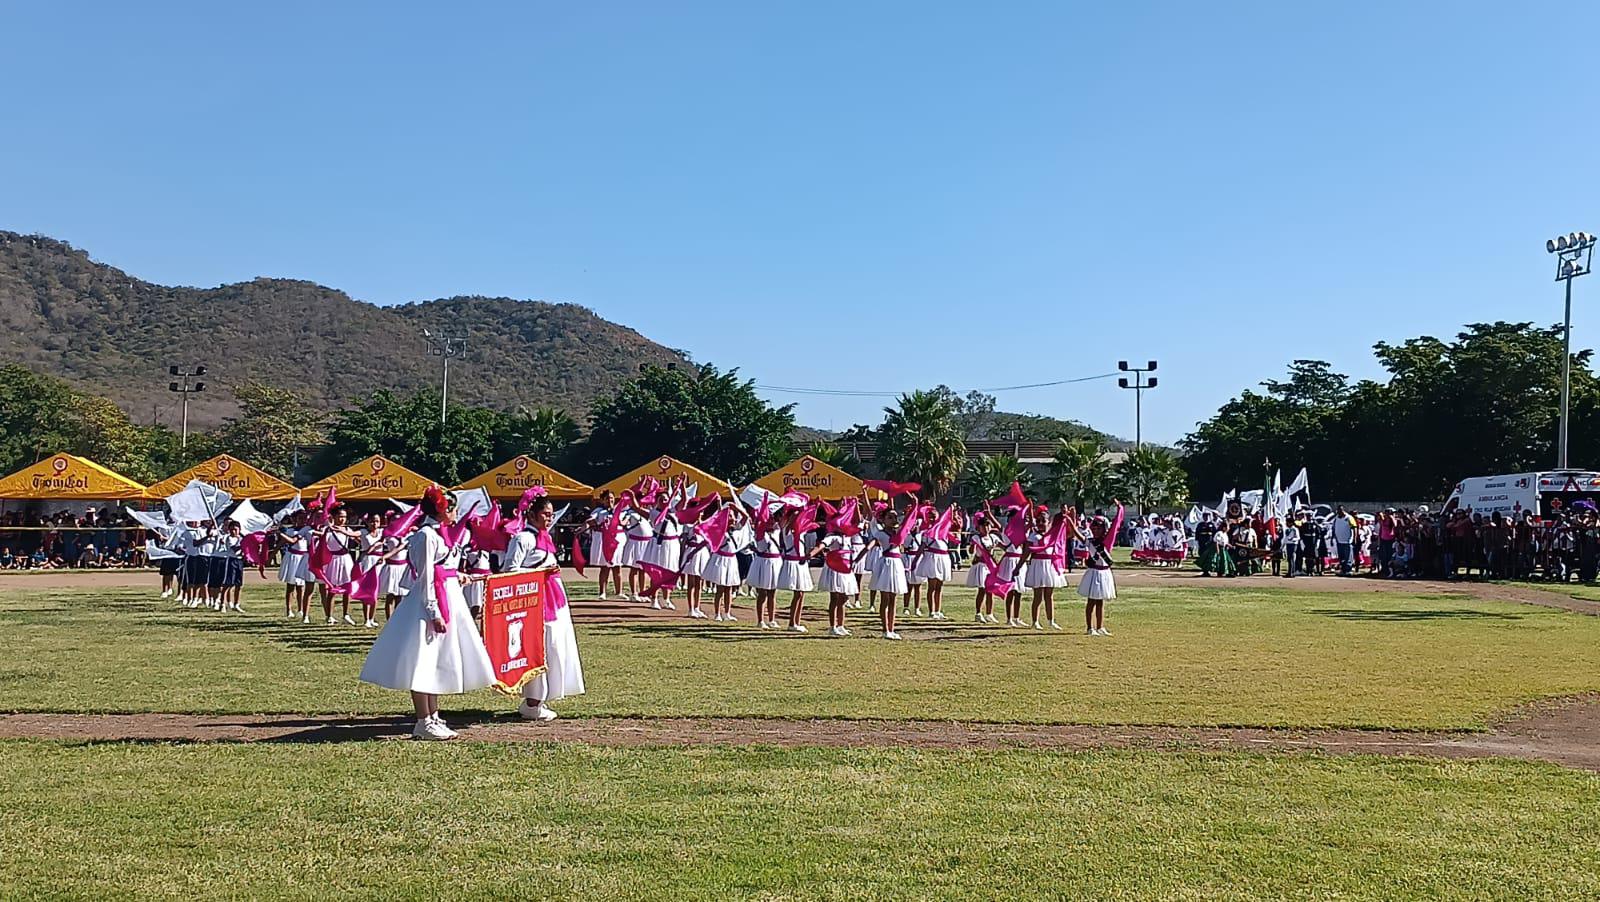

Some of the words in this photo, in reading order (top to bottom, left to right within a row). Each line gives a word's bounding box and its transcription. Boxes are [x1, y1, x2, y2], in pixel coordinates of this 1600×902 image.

[32, 474, 88, 489] ToniCol
[352, 474, 403, 489] ToniCol
[496, 473, 545, 488] ToniCol
[783, 473, 832, 488] ToniCol
